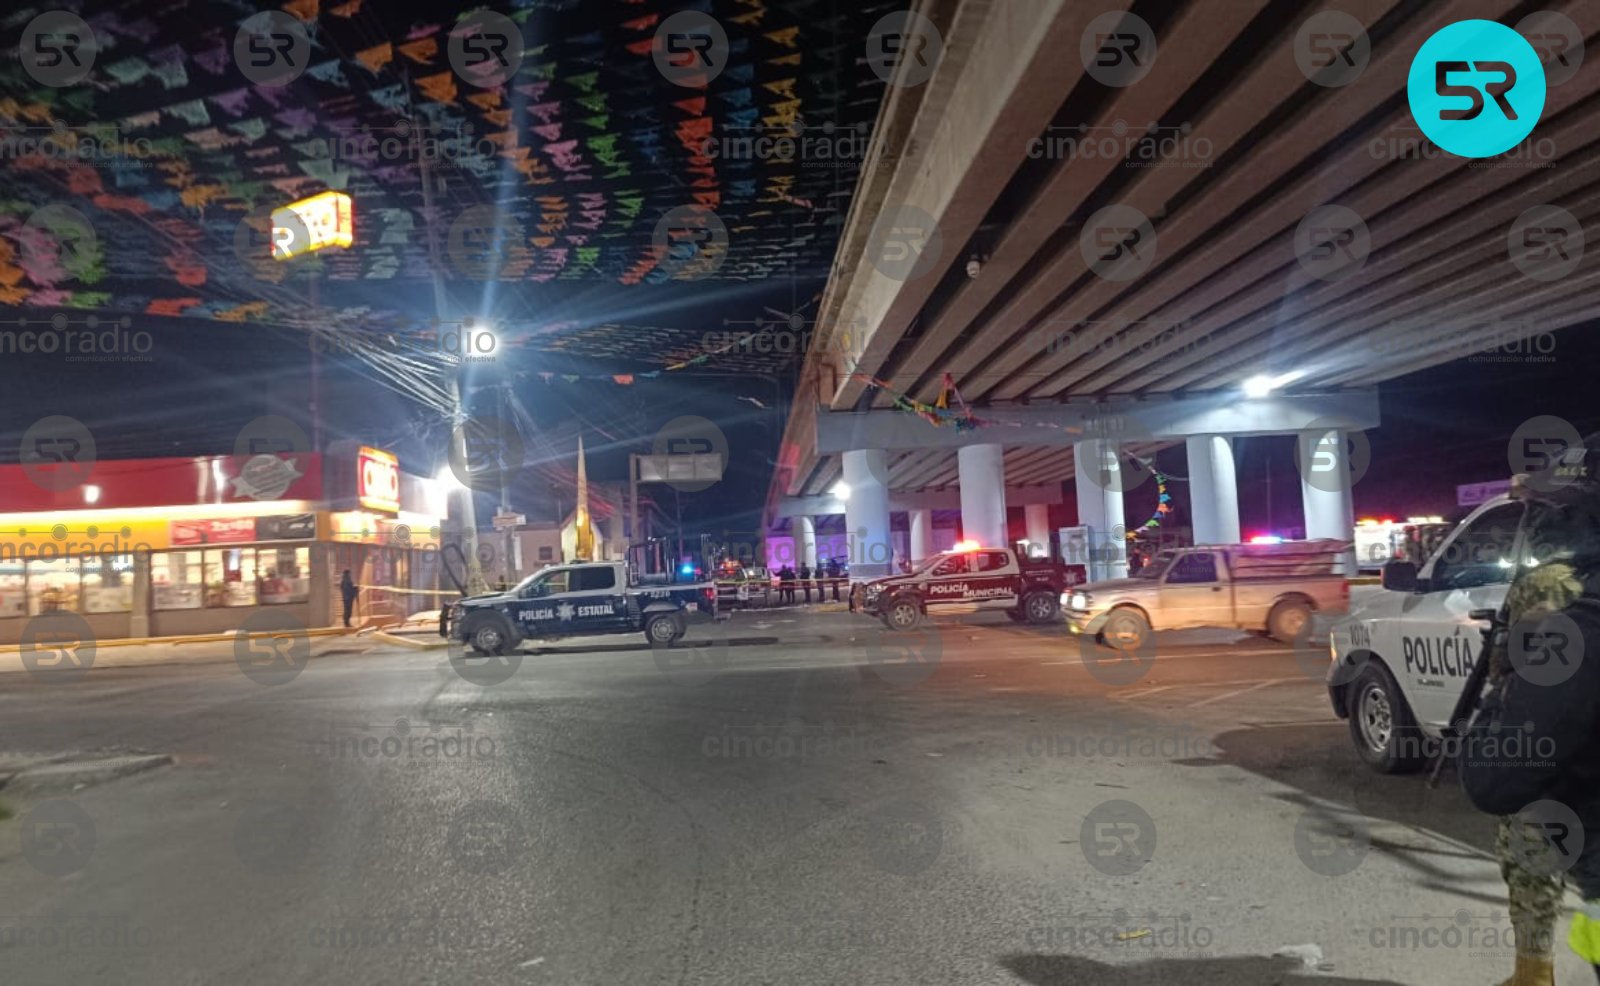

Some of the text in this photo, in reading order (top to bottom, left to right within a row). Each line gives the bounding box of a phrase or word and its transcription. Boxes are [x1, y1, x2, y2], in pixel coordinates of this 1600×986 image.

[364, 461, 398, 499] OO
[930, 582, 1014, 598] POLICÍA MUNICIPAL
[519, 604, 615, 620] POLICÍA ESTATAL
[1350, 624, 1370, 647] 1074
[1402, 626, 1476, 677] POLICÍA
